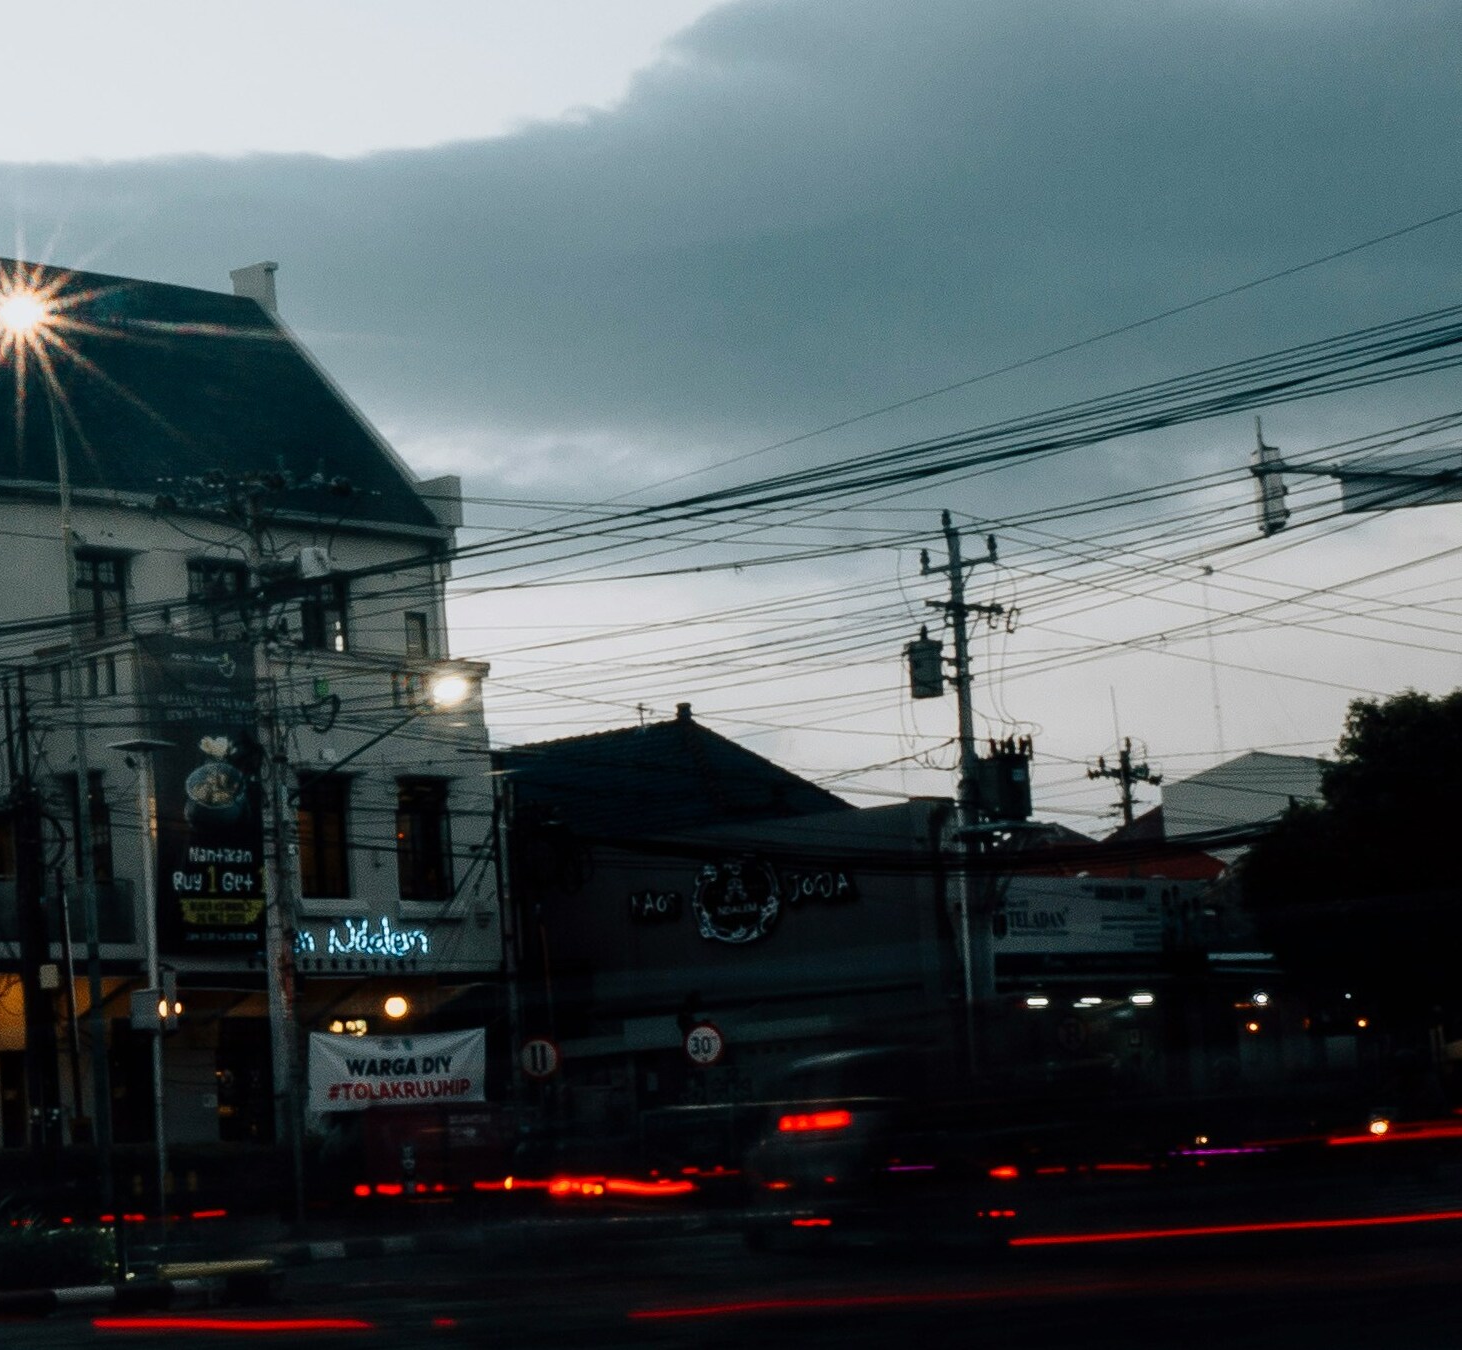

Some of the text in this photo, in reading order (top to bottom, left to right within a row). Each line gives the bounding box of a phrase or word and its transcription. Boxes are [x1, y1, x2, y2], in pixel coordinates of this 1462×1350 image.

[221, 871, 254, 891] Get
[690, 1035, 712, 1055] 30
[346, 1055, 453, 1077] WARGA DIY
[328, 1078, 472, 1102] #TOLAKRUUHIP
